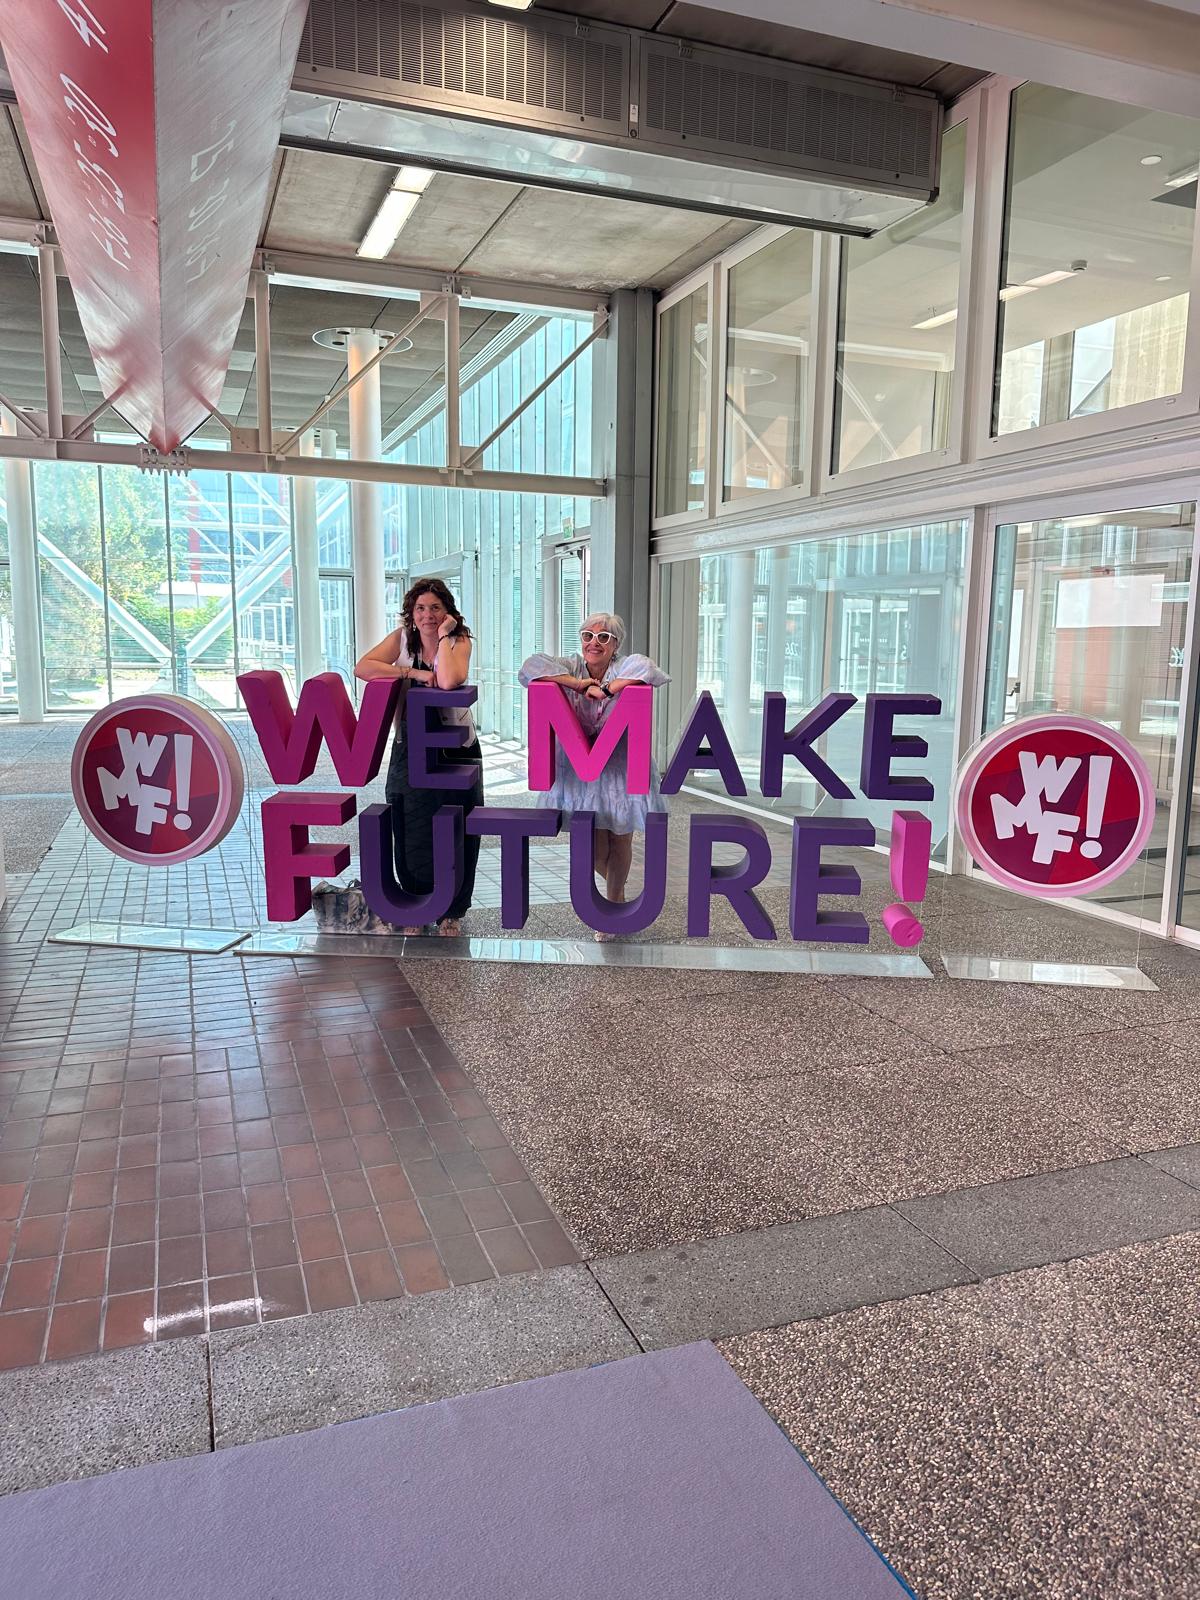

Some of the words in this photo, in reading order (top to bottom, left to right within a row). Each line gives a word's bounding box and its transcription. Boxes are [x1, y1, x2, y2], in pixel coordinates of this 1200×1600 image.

[236, 670, 479, 790] WE
[528, 680, 942, 801] MAKE
[261, 791, 932, 948] FUTURE!
